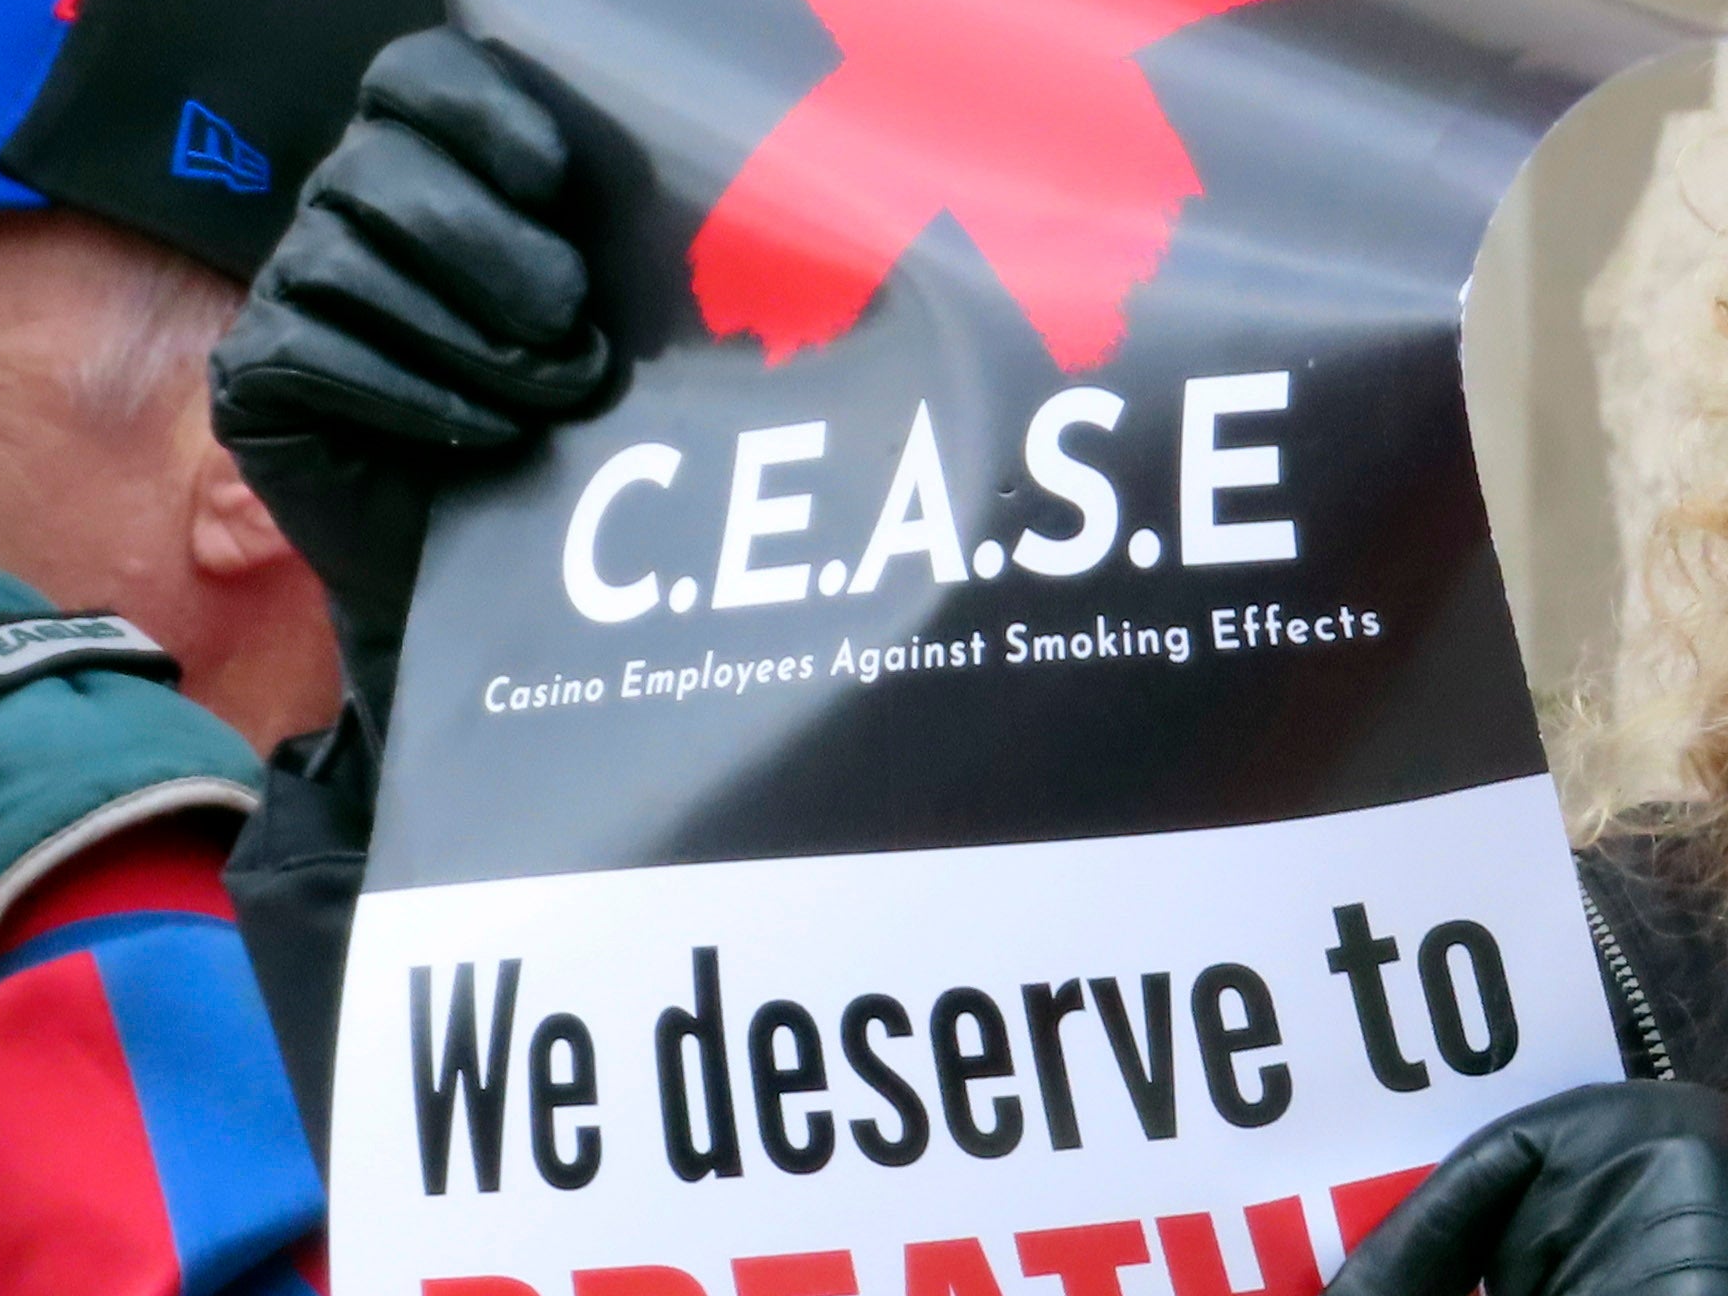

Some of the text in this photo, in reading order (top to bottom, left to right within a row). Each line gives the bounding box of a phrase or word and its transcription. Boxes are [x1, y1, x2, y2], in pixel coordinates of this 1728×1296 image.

[561, 369, 1299, 624] C.E.A.S.E
[484, 603, 1382, 714] Casino Employees Against Smoking Effects
[407, 901, 1522, 1197] We deserve to
